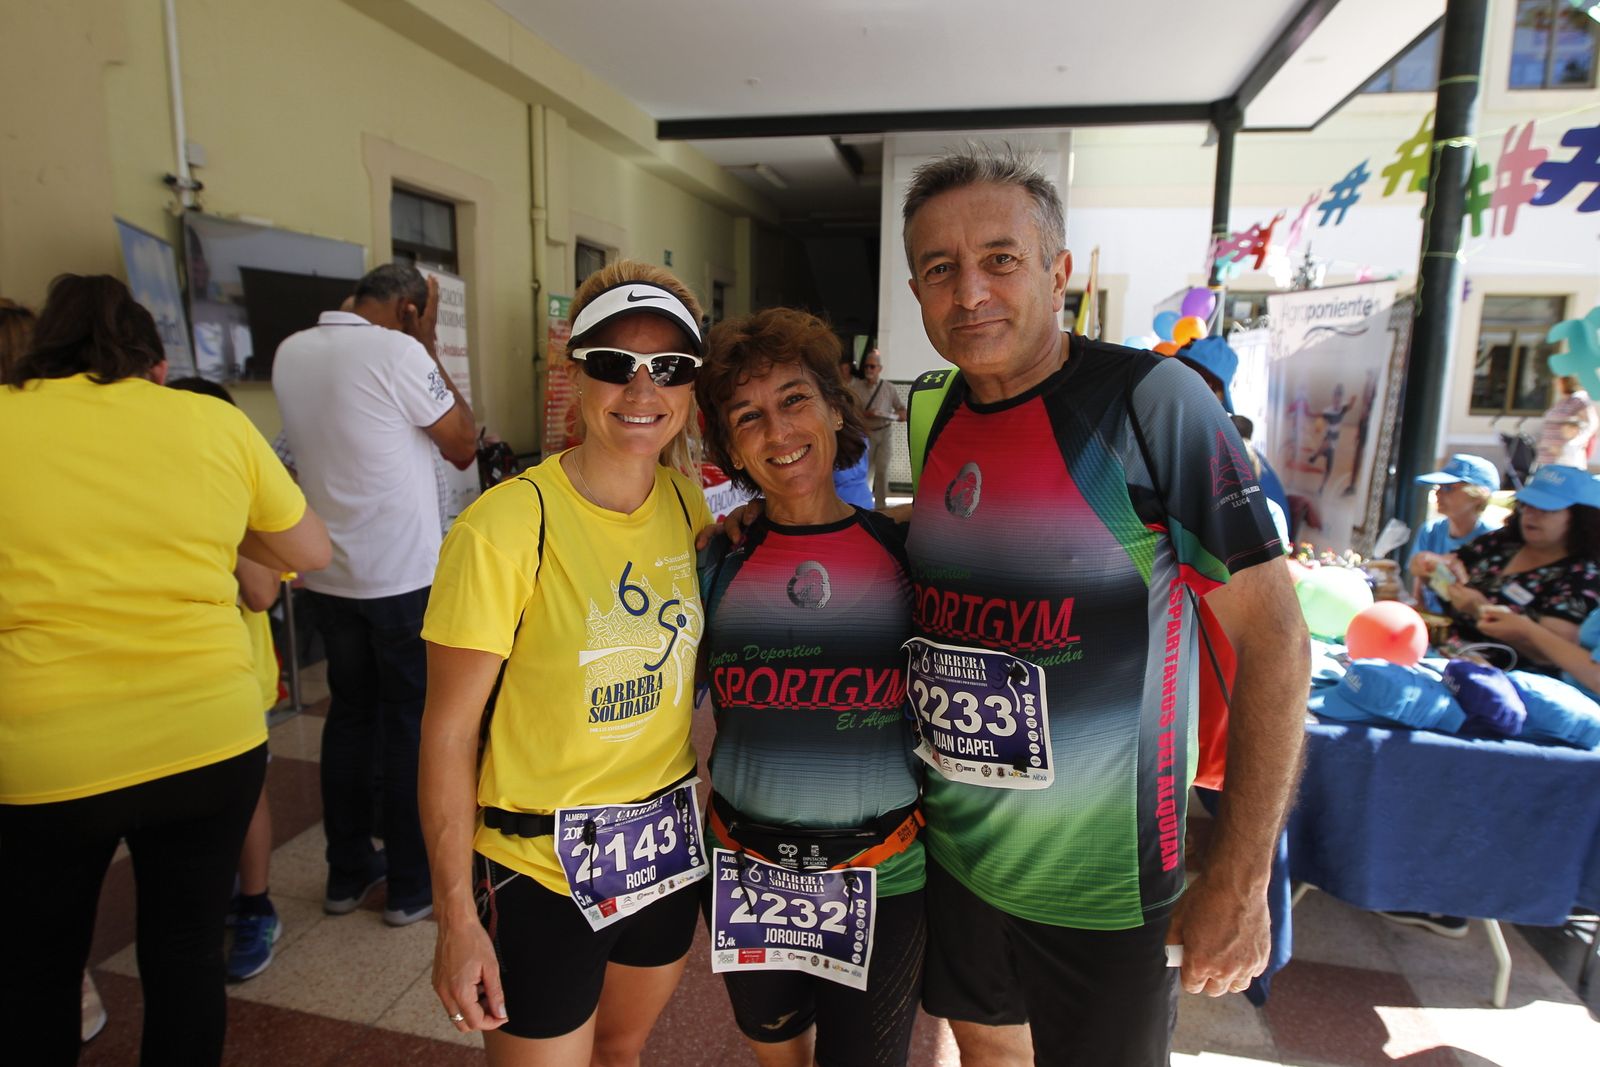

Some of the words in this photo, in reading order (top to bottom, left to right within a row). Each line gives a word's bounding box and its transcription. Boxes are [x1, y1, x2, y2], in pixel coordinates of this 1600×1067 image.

[743, 644, 822, 662] Deportivo
[933, 652, 986, 670] CARRERA
[933, 663, 987, 681] SOLIDARIA
[591, 672, 664, 707] CARRERA
[588, 691, 662, 724] SOLIDARIA
[913, 679, 1018, 737] 2233
[957, 736, 999, 758] CAPEL
[571, 815, 677, 884] 2143
[626, 865, 657, 890] ROCIO
[768, 869, 825, 885] CARRERA
[768, 878, 825, 893] SOLIDARIA
[729, 886, 848, 936] 2232
[764, 927, 824, 949] JORQUERA
